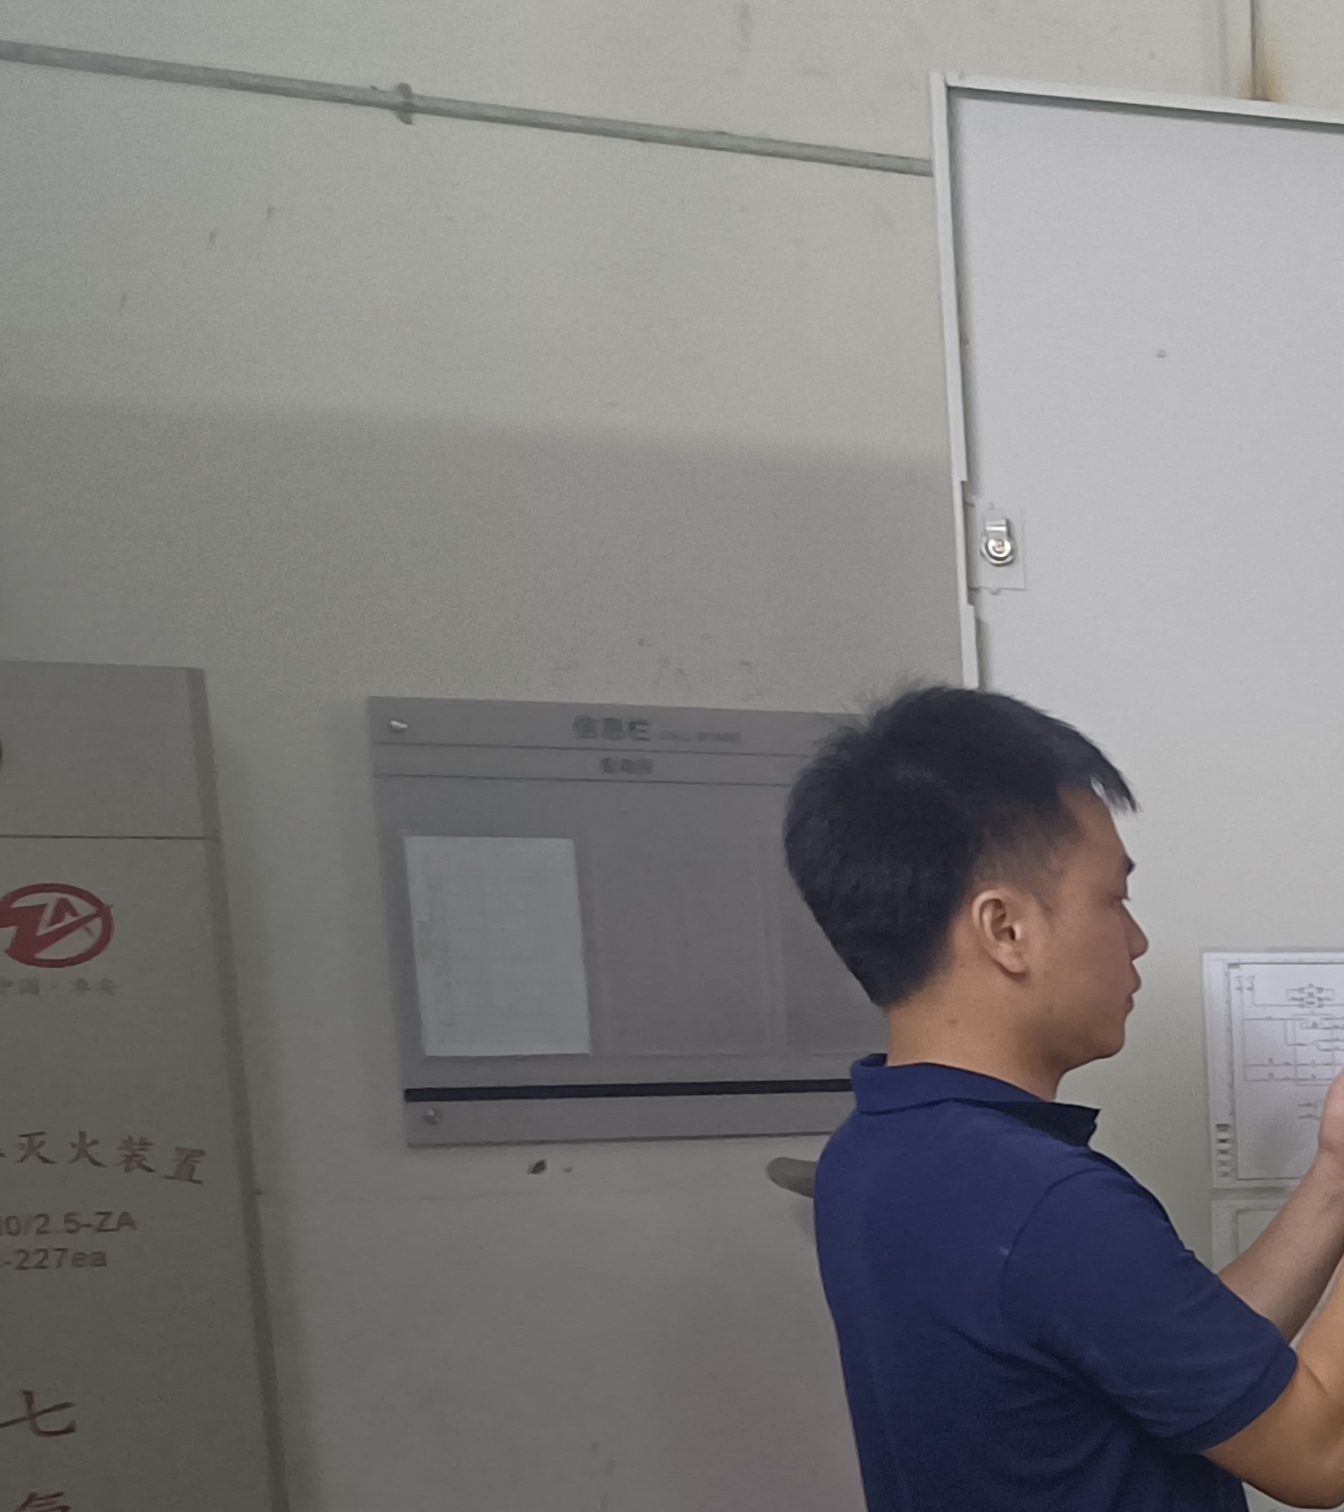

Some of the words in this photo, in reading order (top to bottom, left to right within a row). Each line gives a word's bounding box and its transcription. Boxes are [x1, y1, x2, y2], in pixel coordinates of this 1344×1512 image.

[0, 1127, 206, 1184] 灭火装置
[0, 1211, 137, 1236] 0/2.5-ZA
